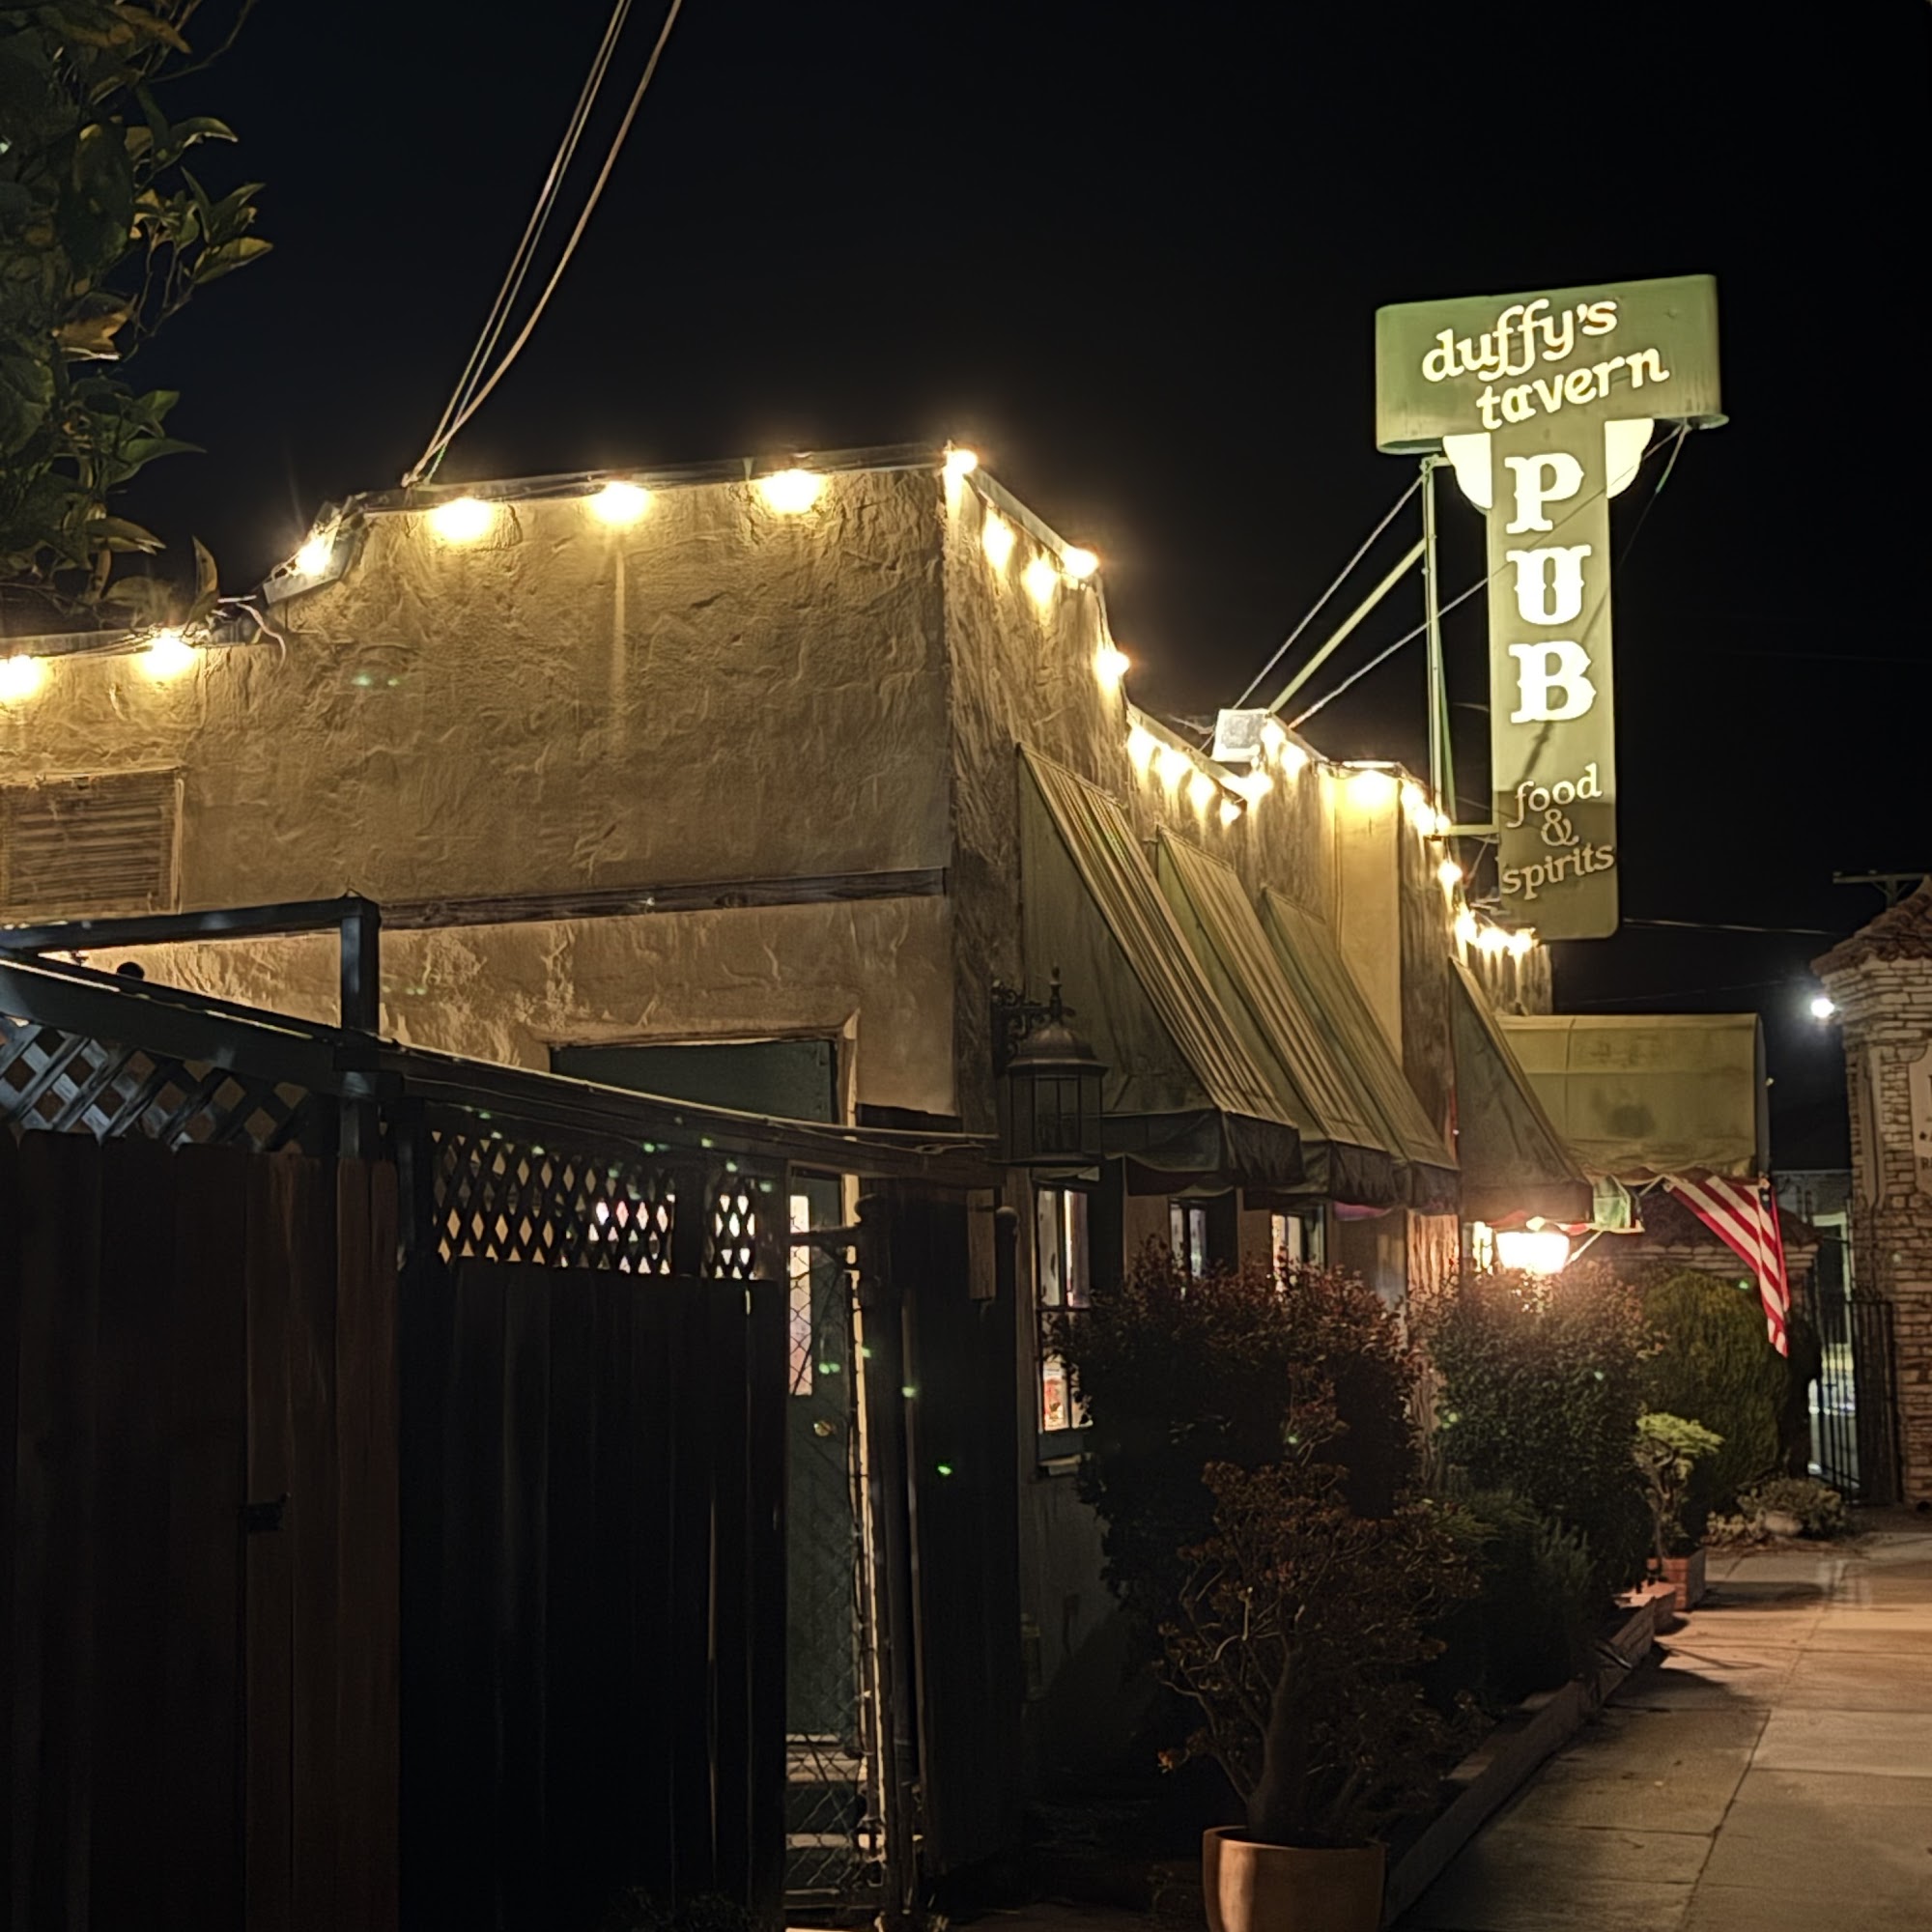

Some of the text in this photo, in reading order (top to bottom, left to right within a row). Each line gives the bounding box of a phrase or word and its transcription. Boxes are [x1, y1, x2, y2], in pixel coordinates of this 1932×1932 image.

[1422, 298, 1618, 384] duffy's
[1476, 348, 1670, 430] tavern
[1504, 452, 1597, 724] PUB
[1506, 762, 1603, 828] food
[1541, 809, 1579, 846] &
[1501, 842, 1614, 900] spirits
